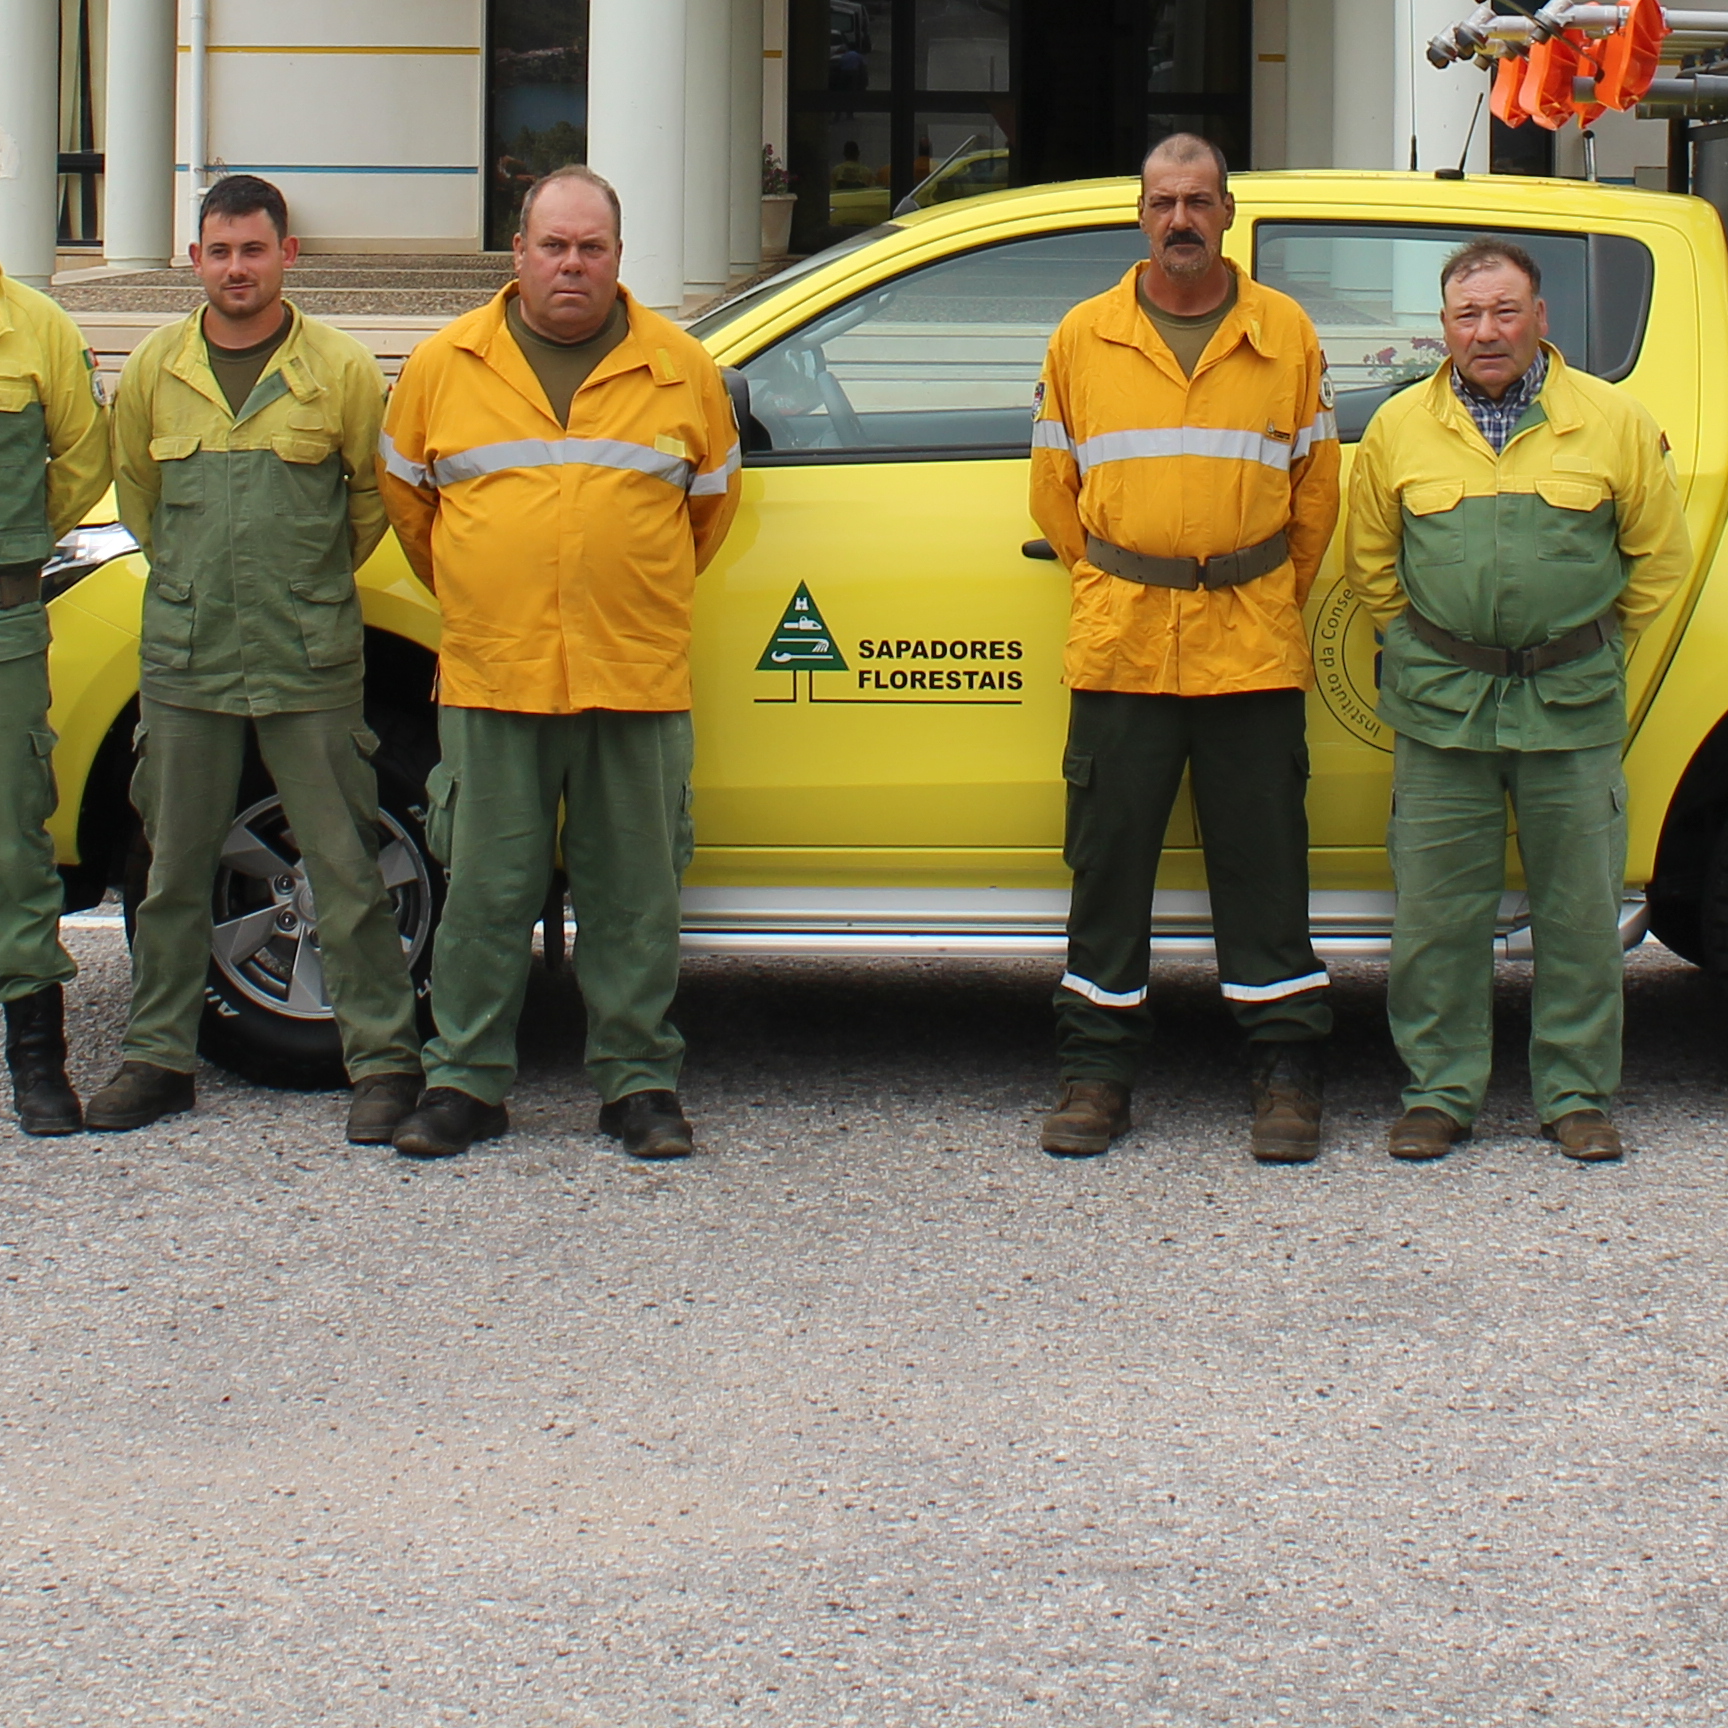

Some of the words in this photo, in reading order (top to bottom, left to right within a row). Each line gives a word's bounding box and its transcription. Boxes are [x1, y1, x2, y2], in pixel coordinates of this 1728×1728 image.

[858, 640, 1023, 660] SAPADORES
[1320, 646, 1335, 668] da
[858, 671, 1023, 690] FLORESTAIS
[1327, 673, 1381, 738] Instituto
